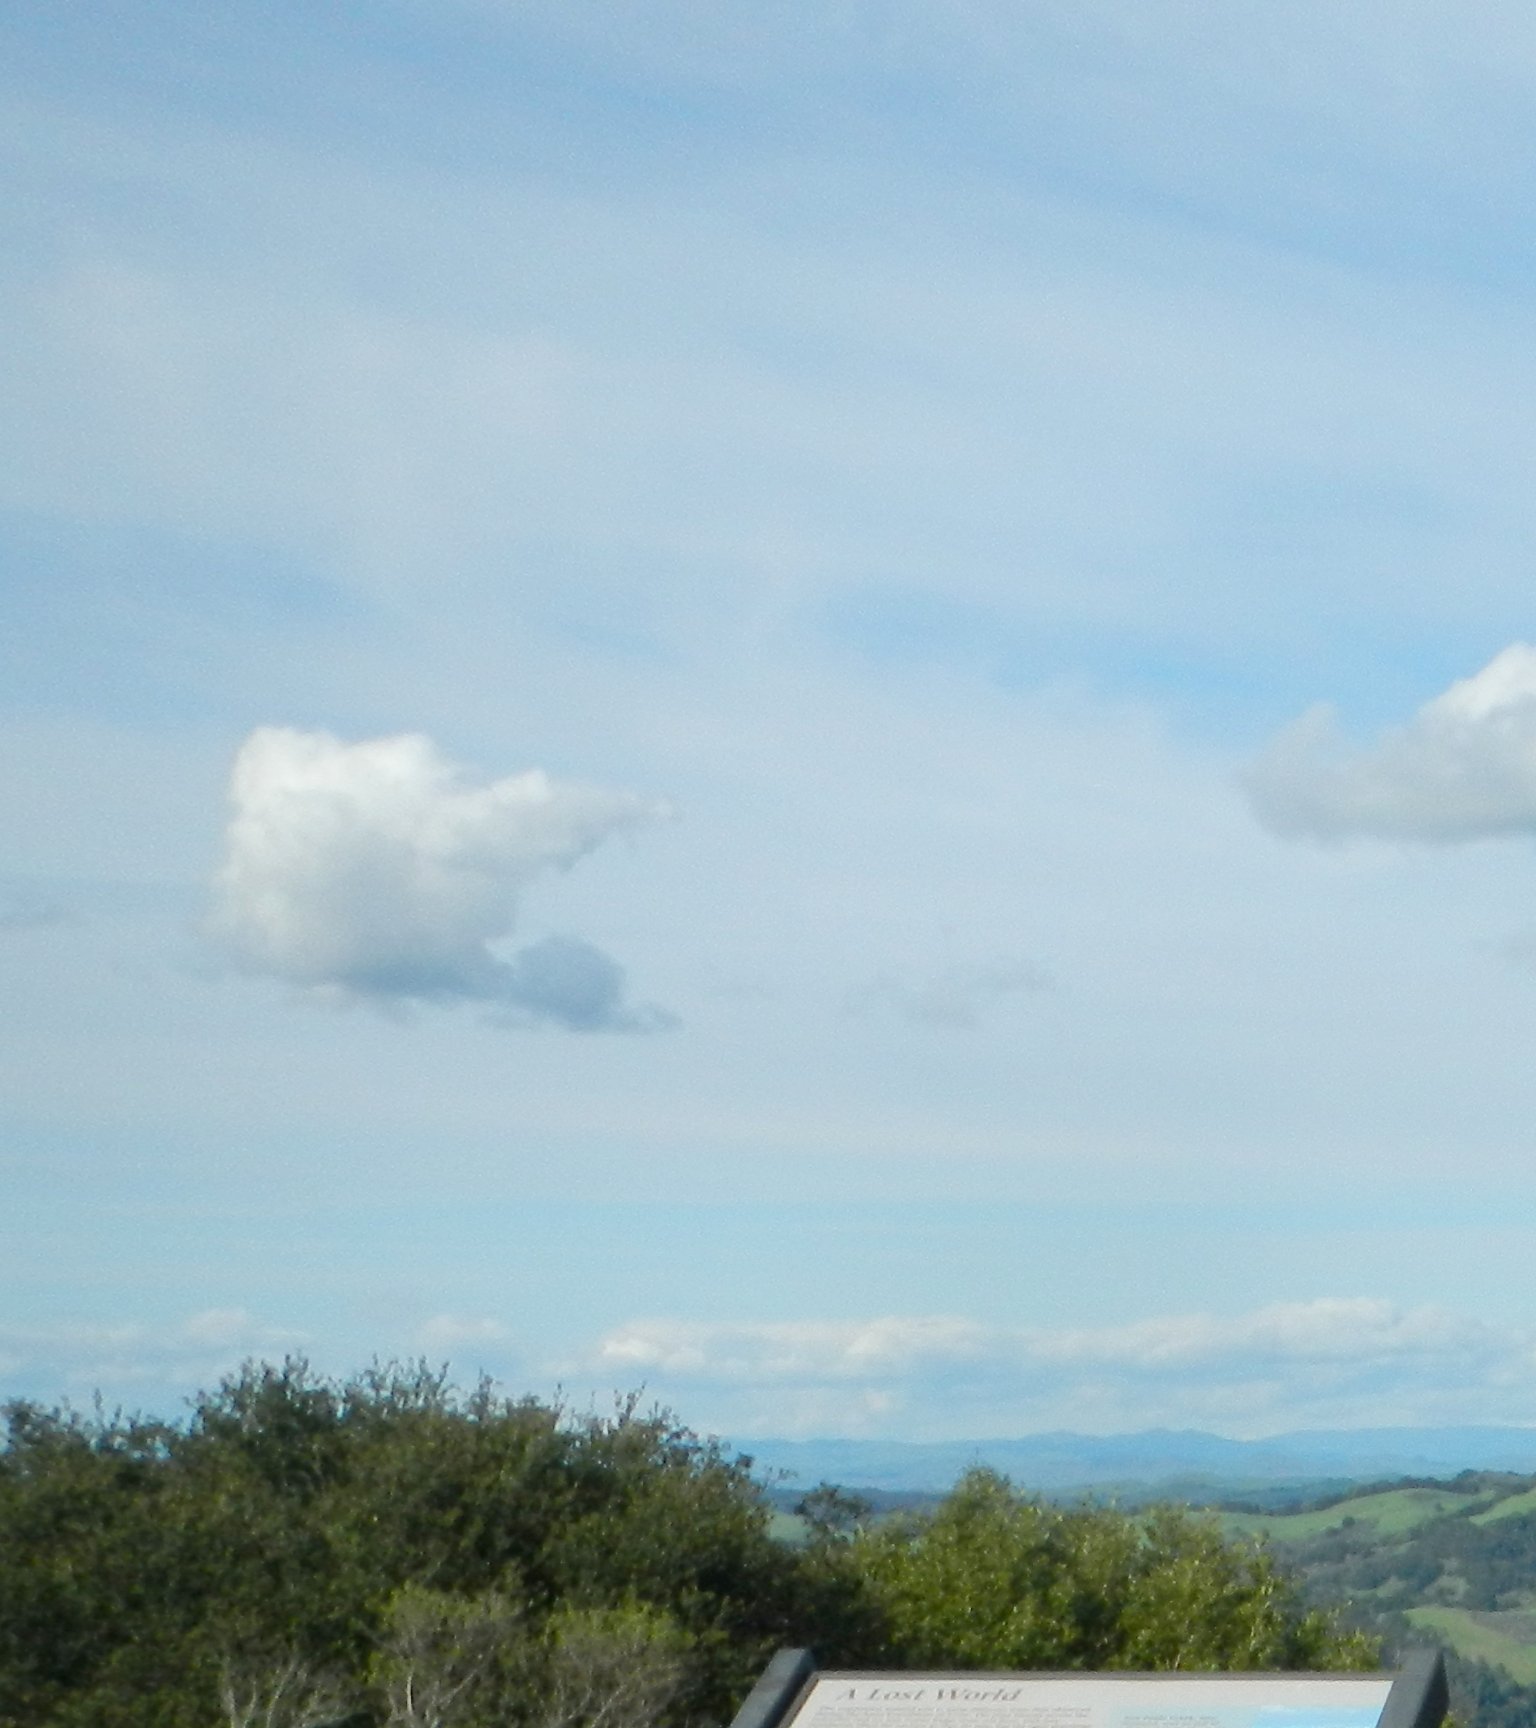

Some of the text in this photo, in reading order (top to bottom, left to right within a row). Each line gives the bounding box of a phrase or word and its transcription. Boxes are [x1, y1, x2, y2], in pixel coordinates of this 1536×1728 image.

[836, 1688, 1024, 1701] A Lost World
